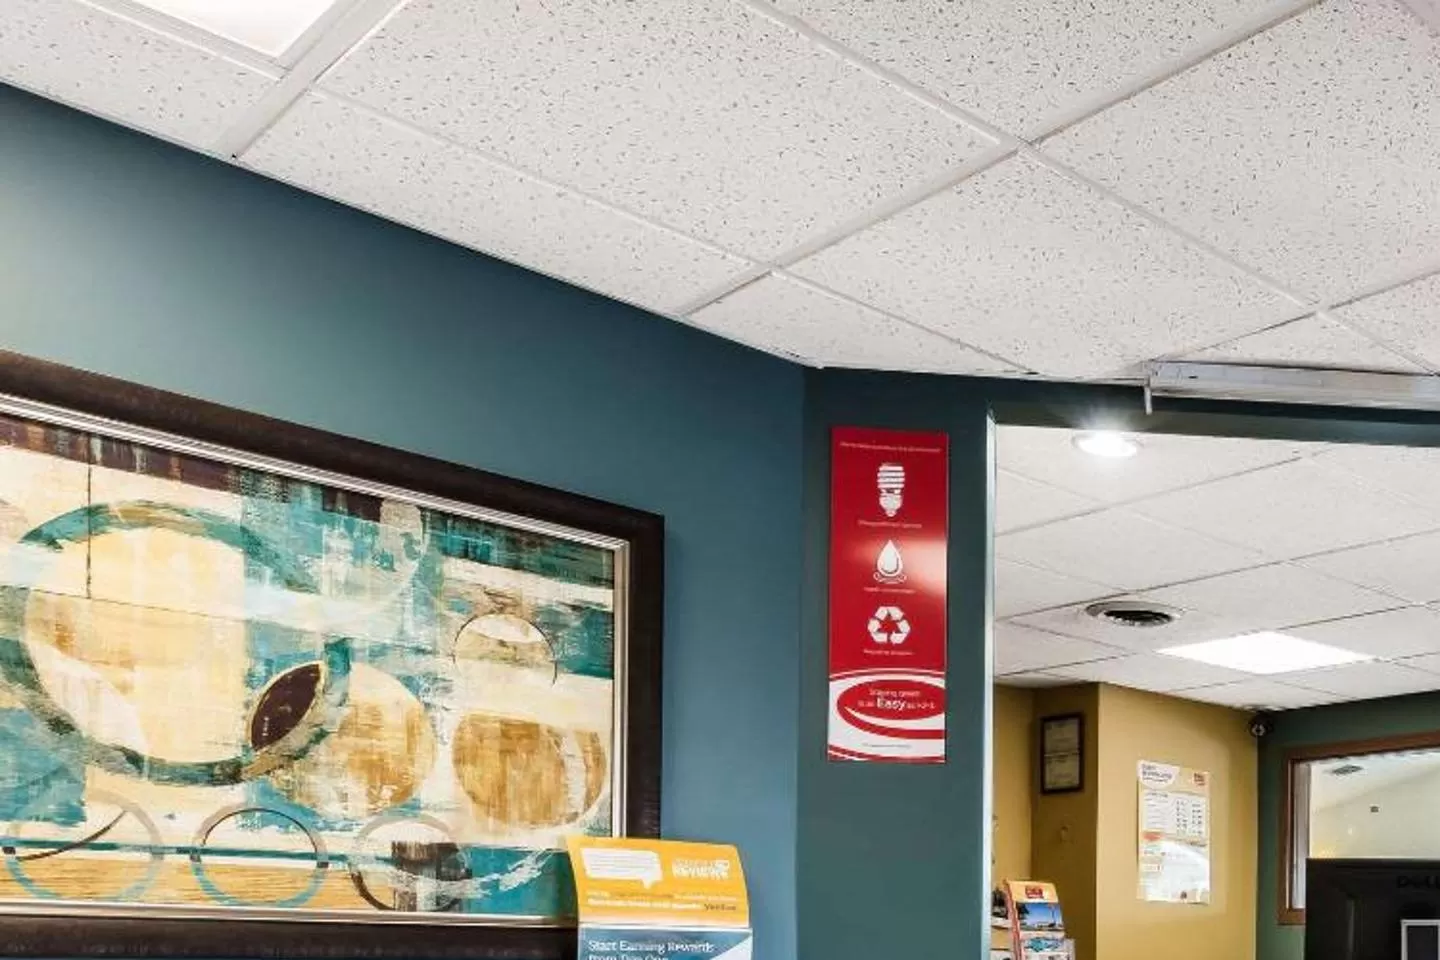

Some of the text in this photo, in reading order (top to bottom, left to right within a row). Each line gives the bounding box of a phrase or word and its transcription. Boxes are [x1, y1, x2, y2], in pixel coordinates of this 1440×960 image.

[876, 697, 906, 711] Easy
[588, 939, 715, 954] Start Earning Rewards
